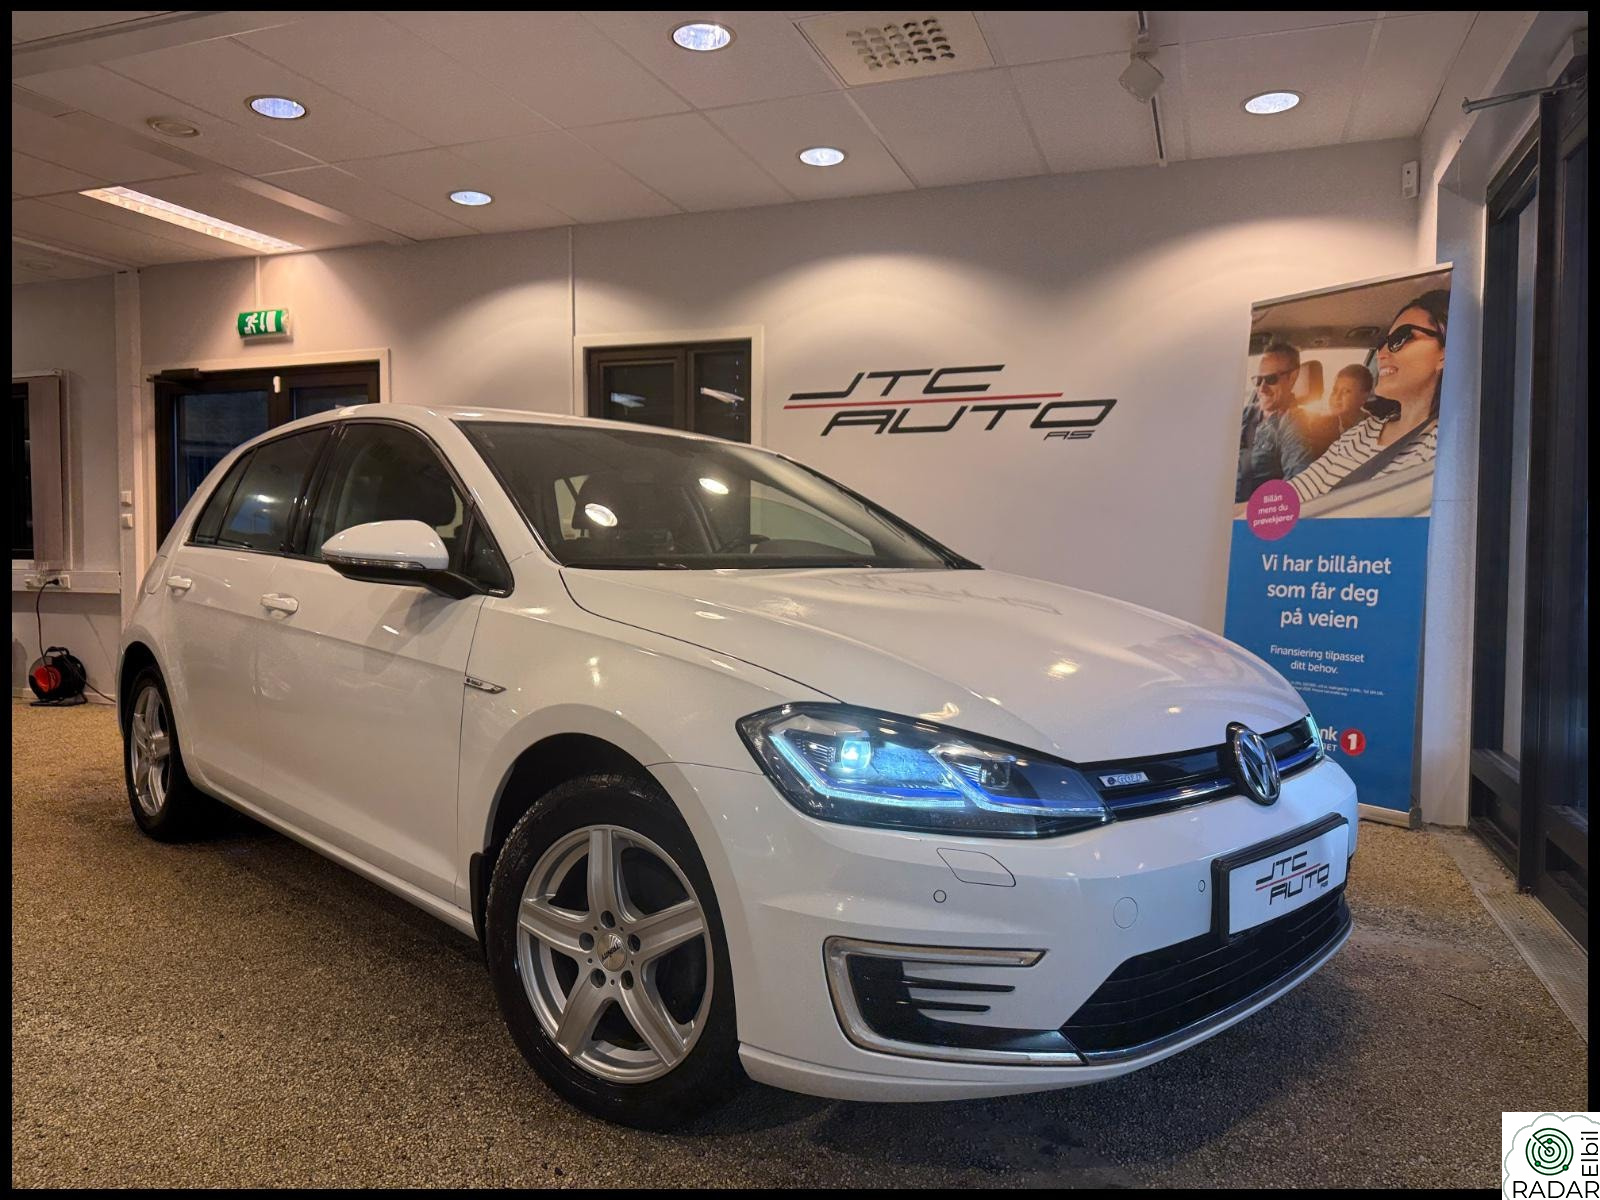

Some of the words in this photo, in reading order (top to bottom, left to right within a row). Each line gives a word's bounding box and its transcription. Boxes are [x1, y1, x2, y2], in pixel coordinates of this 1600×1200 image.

[788, 364, 1005, 400] JTC
[820, 398, 1118, 436] AUTO
[1043, 430, 1095, 441] AS
[1278, 503, 1289, 512] du
[1262, 554, 1278, 571] Vi
[1282, 554, 1313, 572] har
[1317, 554, 1392, 575] billånet
[1267, 583, 1305, 599] som
[1311, 582, 1336, 600] får
[1340, 583, 1379, 607] deg
[1280, 607, 1303, 628] på
[1308, 609, 1359, 629] veien
[1270, 644, 1323, 661] Finansiering
[1325, 650, 1365, 663] tilpasset
[1290, 660, 1306, 671] ditt
[1308, 661, 1339, 674] behov.
[1256, 850, 1307, 885] JTC
[1269, 863, 1330, 905] AUTO
